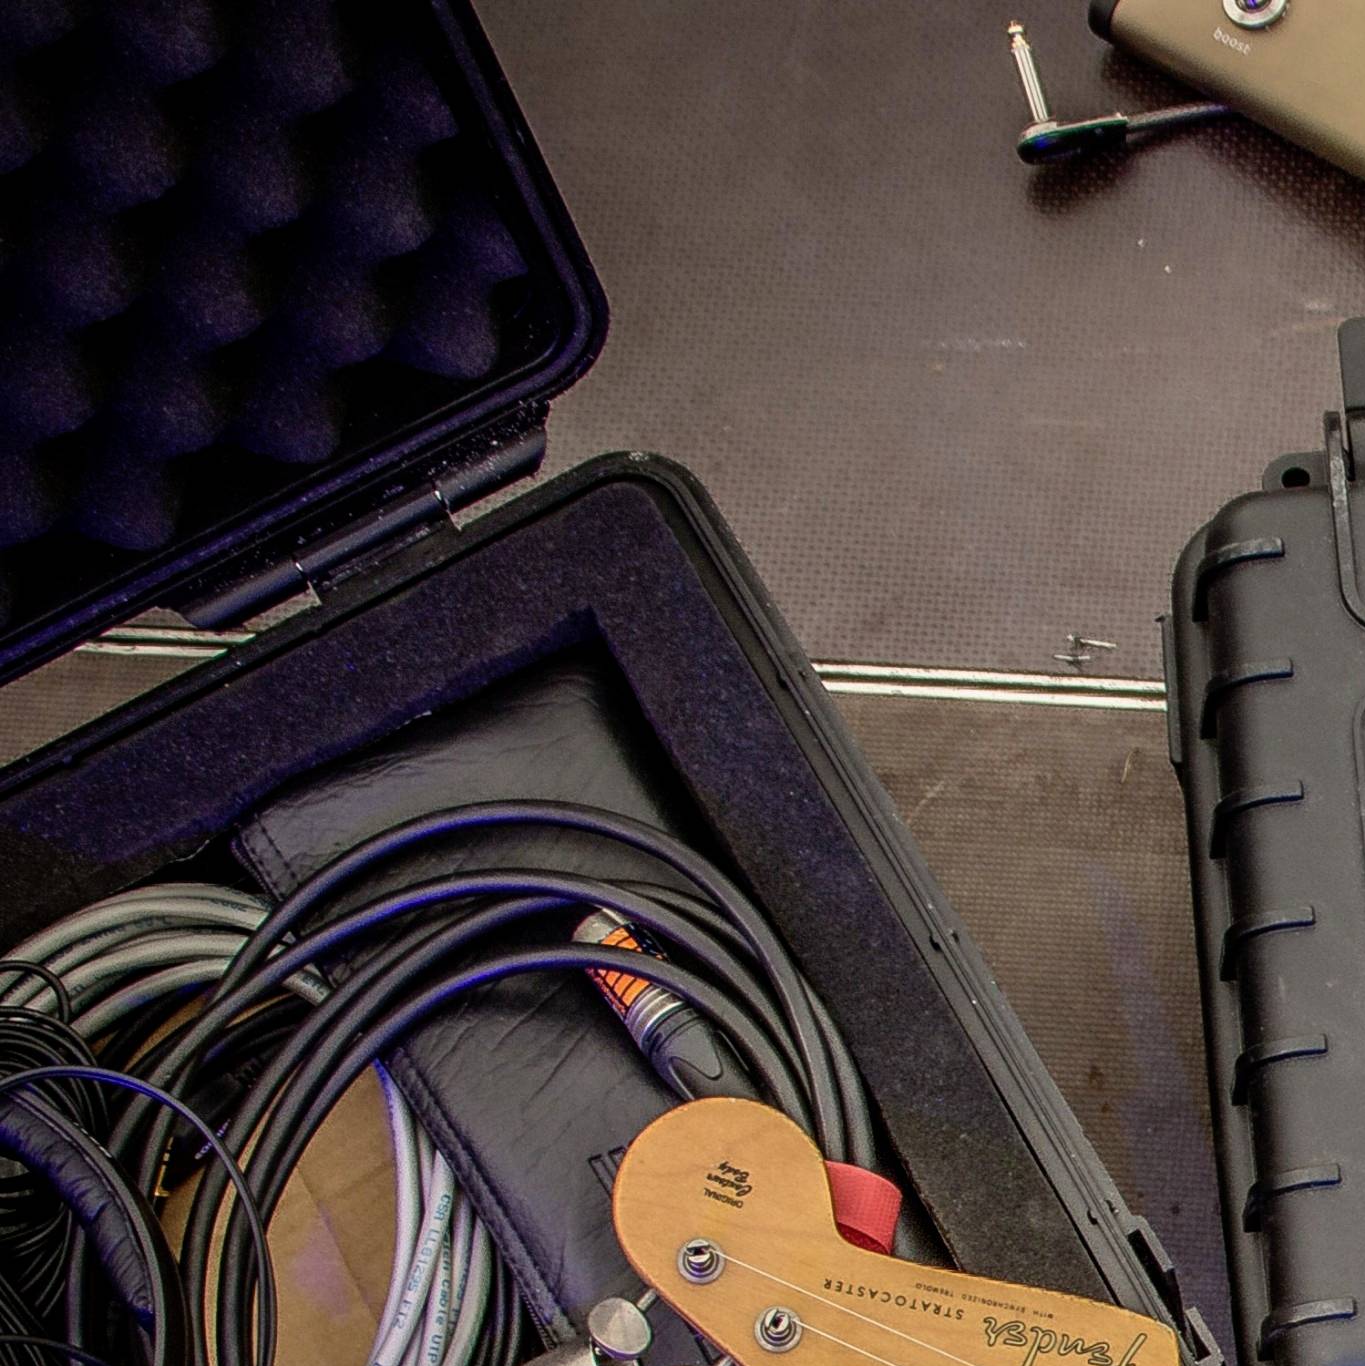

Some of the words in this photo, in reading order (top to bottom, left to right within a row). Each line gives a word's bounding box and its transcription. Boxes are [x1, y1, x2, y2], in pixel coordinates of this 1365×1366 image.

[1212, 26, 1252, 56] boost
[703, 1186, 744, 1210] ORIGINAL
[823, 1277, 966, 1321] STRATOCASTER
[914, 1281, 956, 1299] TREMOLO
